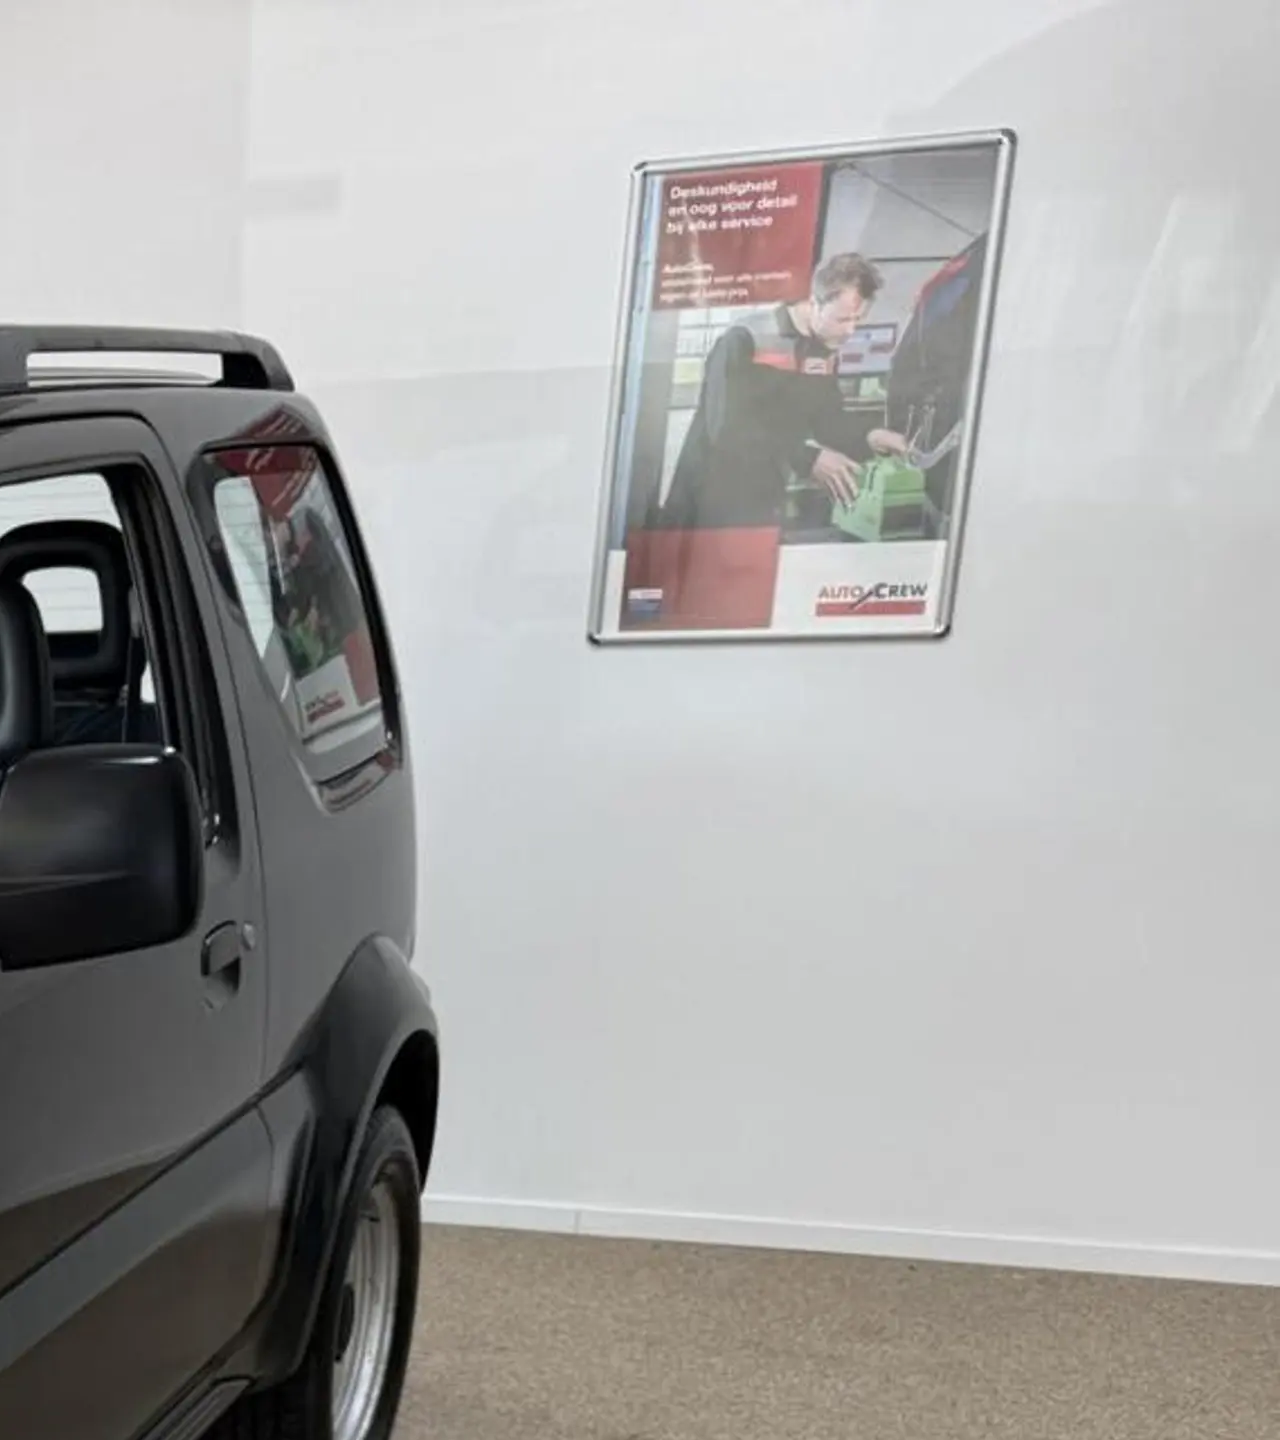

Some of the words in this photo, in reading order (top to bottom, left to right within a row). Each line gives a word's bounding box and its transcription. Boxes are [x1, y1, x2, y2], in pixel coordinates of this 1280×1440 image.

[671, 177, 778, 200] Deskundigheid
[668, 206, 687, 217] en
[689, 203, 718, 216] oog
[721, 200, 754, 212] voor
[757, 194, 798, 209] detail
[721, 216, 774, 229] service
